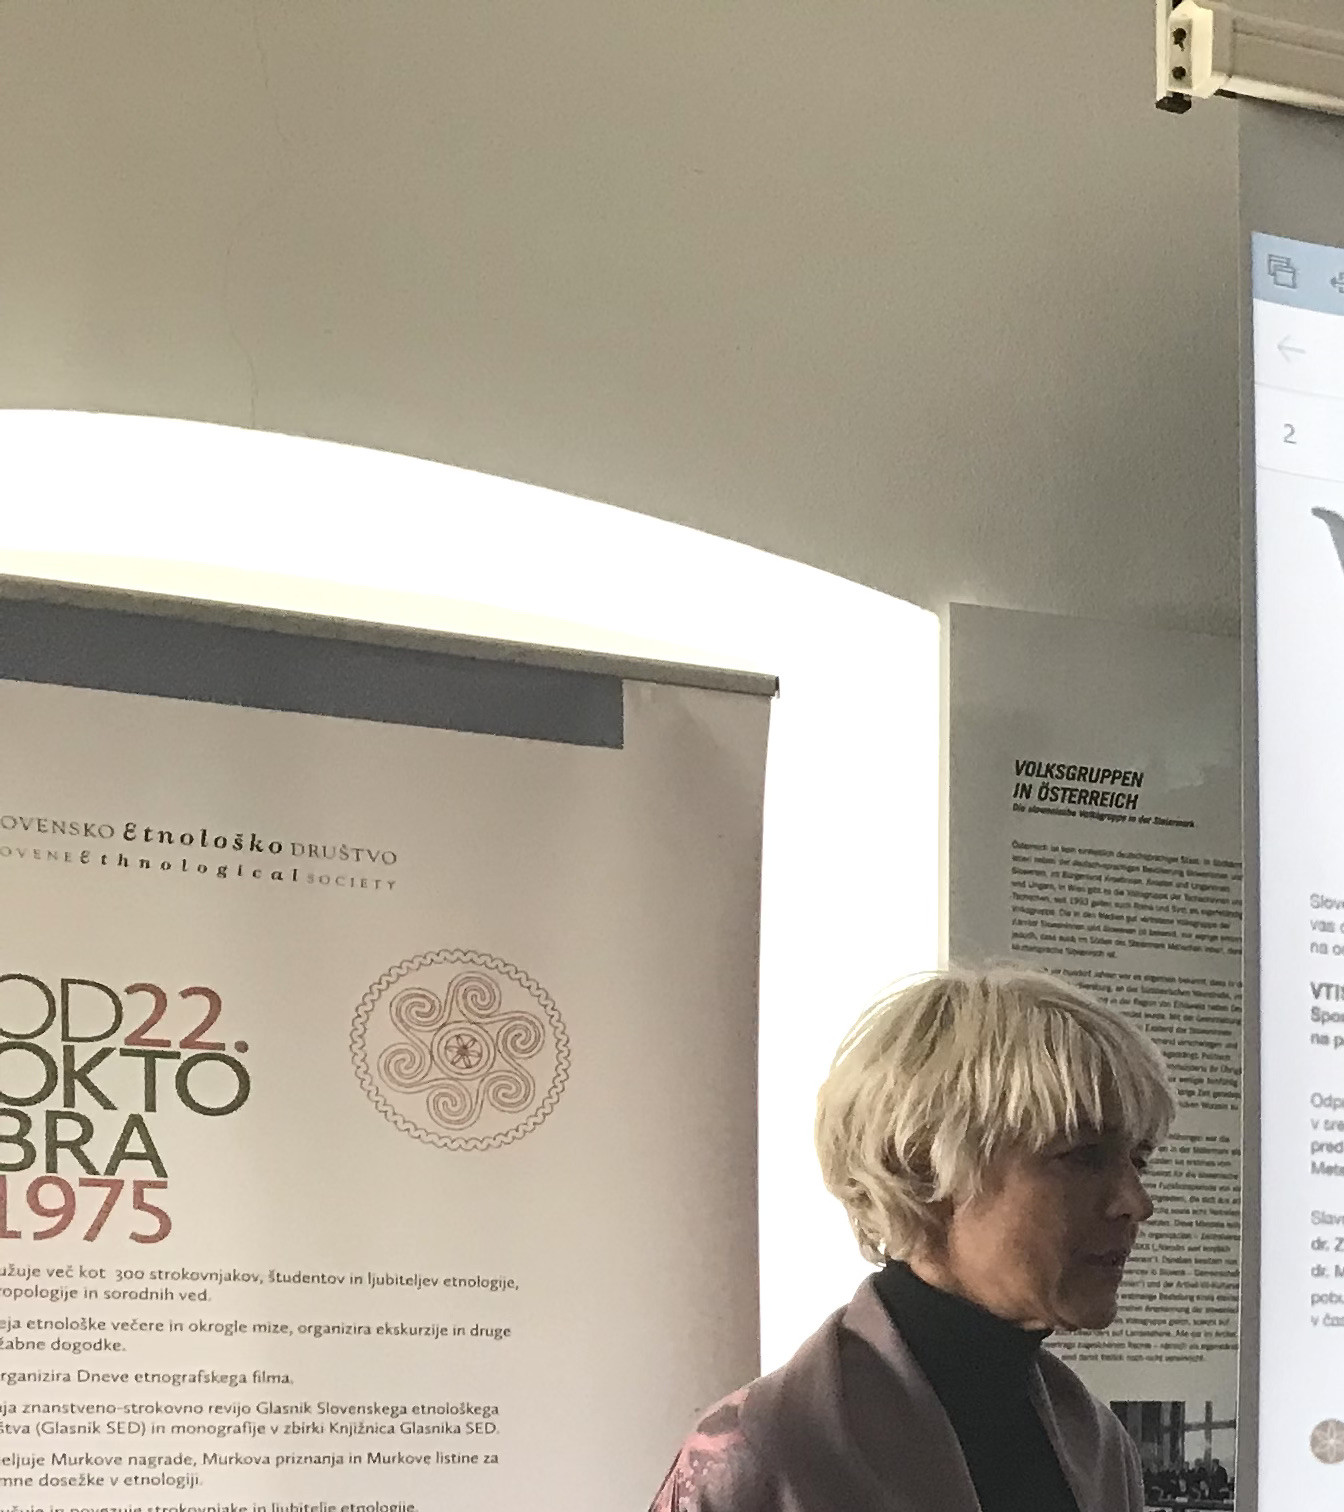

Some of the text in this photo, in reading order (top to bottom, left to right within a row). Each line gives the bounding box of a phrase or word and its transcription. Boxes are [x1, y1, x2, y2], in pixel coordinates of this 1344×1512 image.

[1282, 425, 1297, 445] 2
[1014, 759, 1144, 788] VOLKSGRUPPEN
[1012, 781, 1139, 810] IN ÖSTERREICH
[291, 840, 398, 866] DRUŠTVO
[0, 1041, 251, 1116] OKTO
[0, 1107, 169, 1178] BRA
[0, 1174, 172, 1244] 1975
[46, 1265, 73, 1279] več
[79, 1264, 106, 1280] kot
[116, 1269, 144, 1283] 300
[149, 1267, 263, 1285] strokovnjakov,
[268, 1269, 345, 1285] študentov
[350, 1276, 363, 1285] in
[368, 1271, 438, 1290] ljubiteljev
[443, 1274, 519, 1292] etnologije,
[27, 1316, 106, 1331] etnološke
[111, 1318, 164, 1332] večere
[170, 1320, 183, 1333] in
[189, 1319, 247, 1336] okrogle
[253, 1324, 293, 1336] mize,
[298, 1323, 371, 1339] organizira
[376, 1321, 448, 1340] ekskurzije
[453, 1326, 465, 1336] in
[470, 1324, 511, 1341] druge
[1, 1368, 293, 1388] rganizira Dneve etnografskega filma.
[22, 1401, 499, 1419] znanstveno-strokovno revijo Glasnik Slovenskega etnološkega
[2, 1451, 498, 1470] eljuje Murkove nagrade, Murkova priznanja in Murkove listine za
